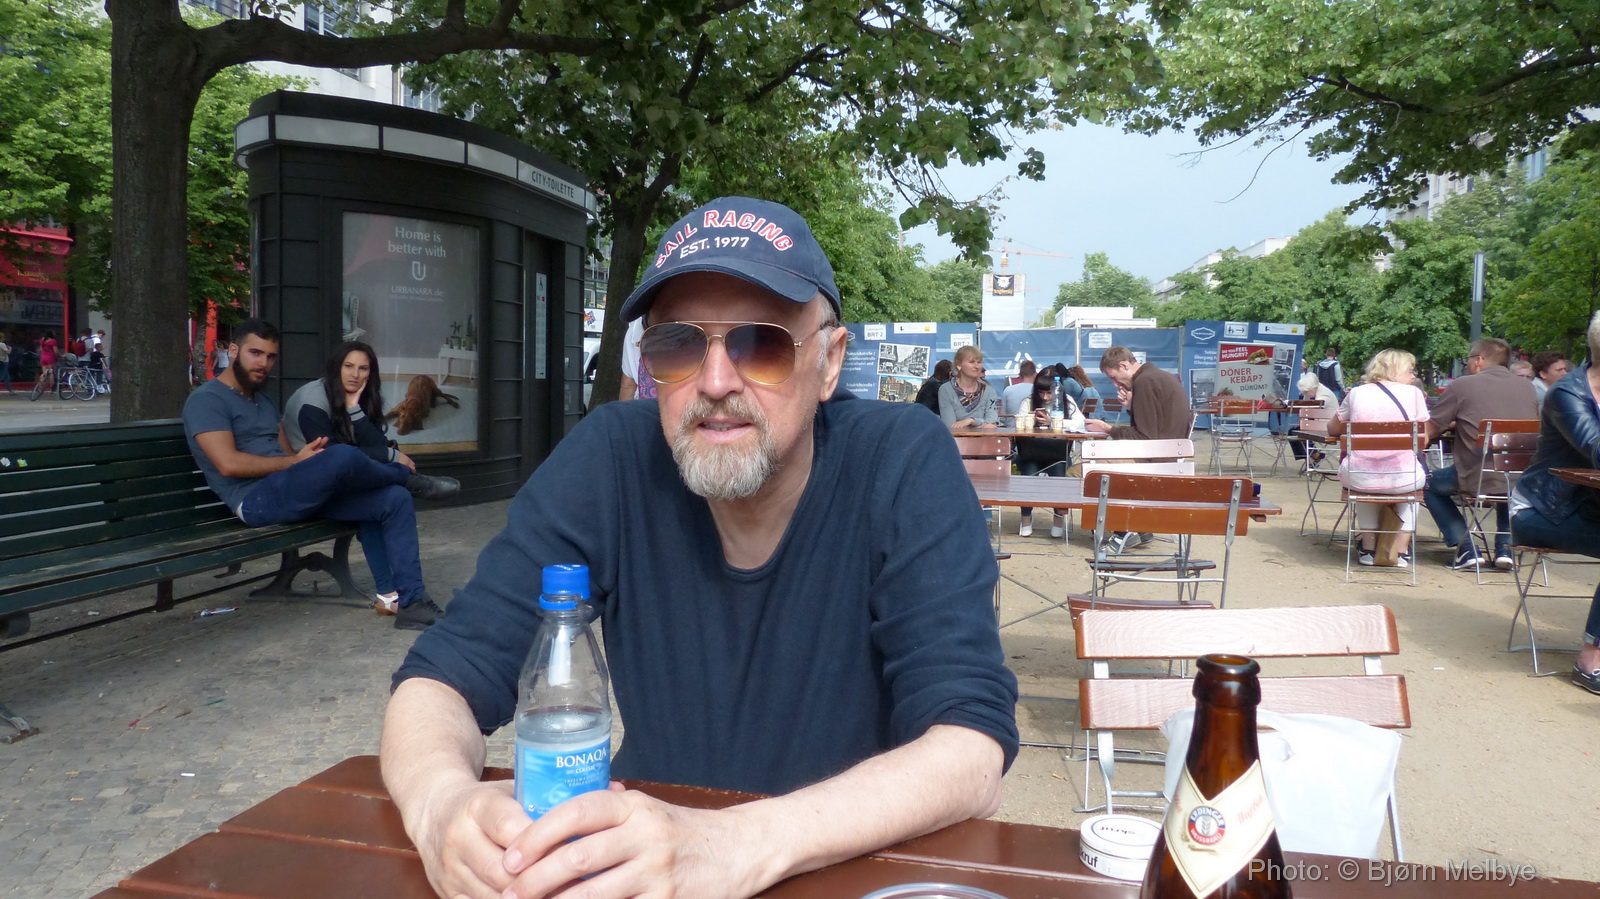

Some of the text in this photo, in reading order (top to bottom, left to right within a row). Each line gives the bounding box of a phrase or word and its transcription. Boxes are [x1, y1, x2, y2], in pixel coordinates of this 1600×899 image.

[531, 170, 575, 198] CITY-TOILETTE
[395, 226, 442, 243] Home is
[655, 209, 794, 268] SAIL RACING
[388, 240, 446, 258] better with
[679, 236, 750, 259] EST. 1977
[1220, 367, 1252, 377] DÖNER
[1230, 374, 1263, 384] KEBAP?
[556, 746, 607, 768] BONAQA
[1190, 807, 1226, 827] ERDINGER
